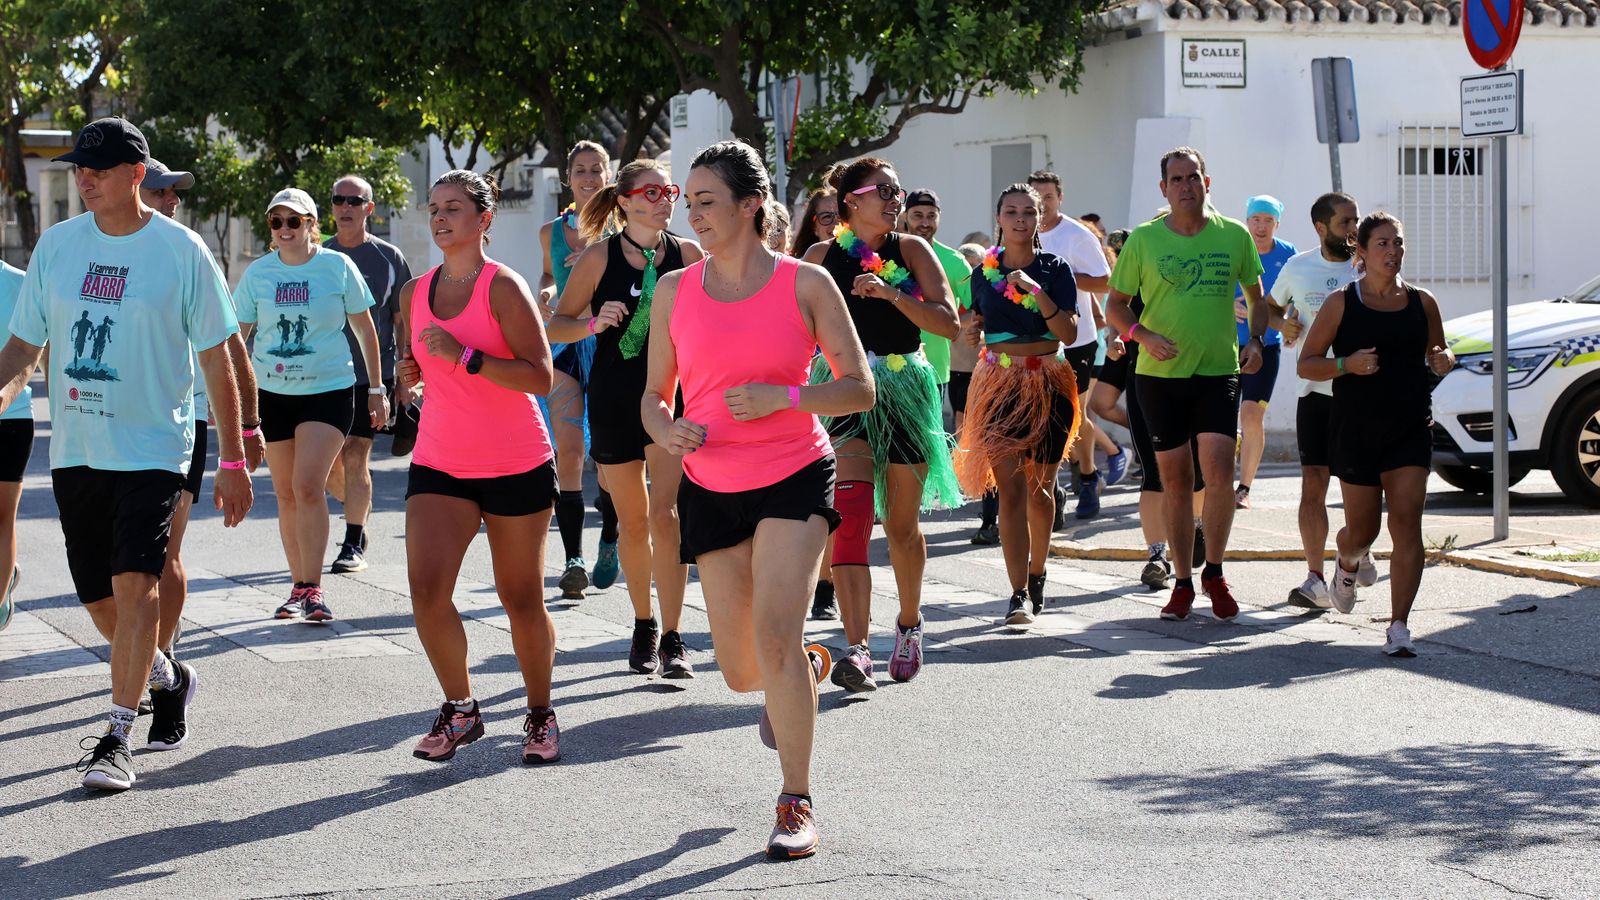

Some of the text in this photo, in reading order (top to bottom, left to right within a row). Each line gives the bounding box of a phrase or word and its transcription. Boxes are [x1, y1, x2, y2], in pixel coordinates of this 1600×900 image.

[1201, 48, 1240, 57] CALLE
[89, 262, 129, 277] V carrera del
[82, 274, 126, 299] BARRO
[276, 287, 309, 303] BARRO
[94, 391, 104, 399] Km
